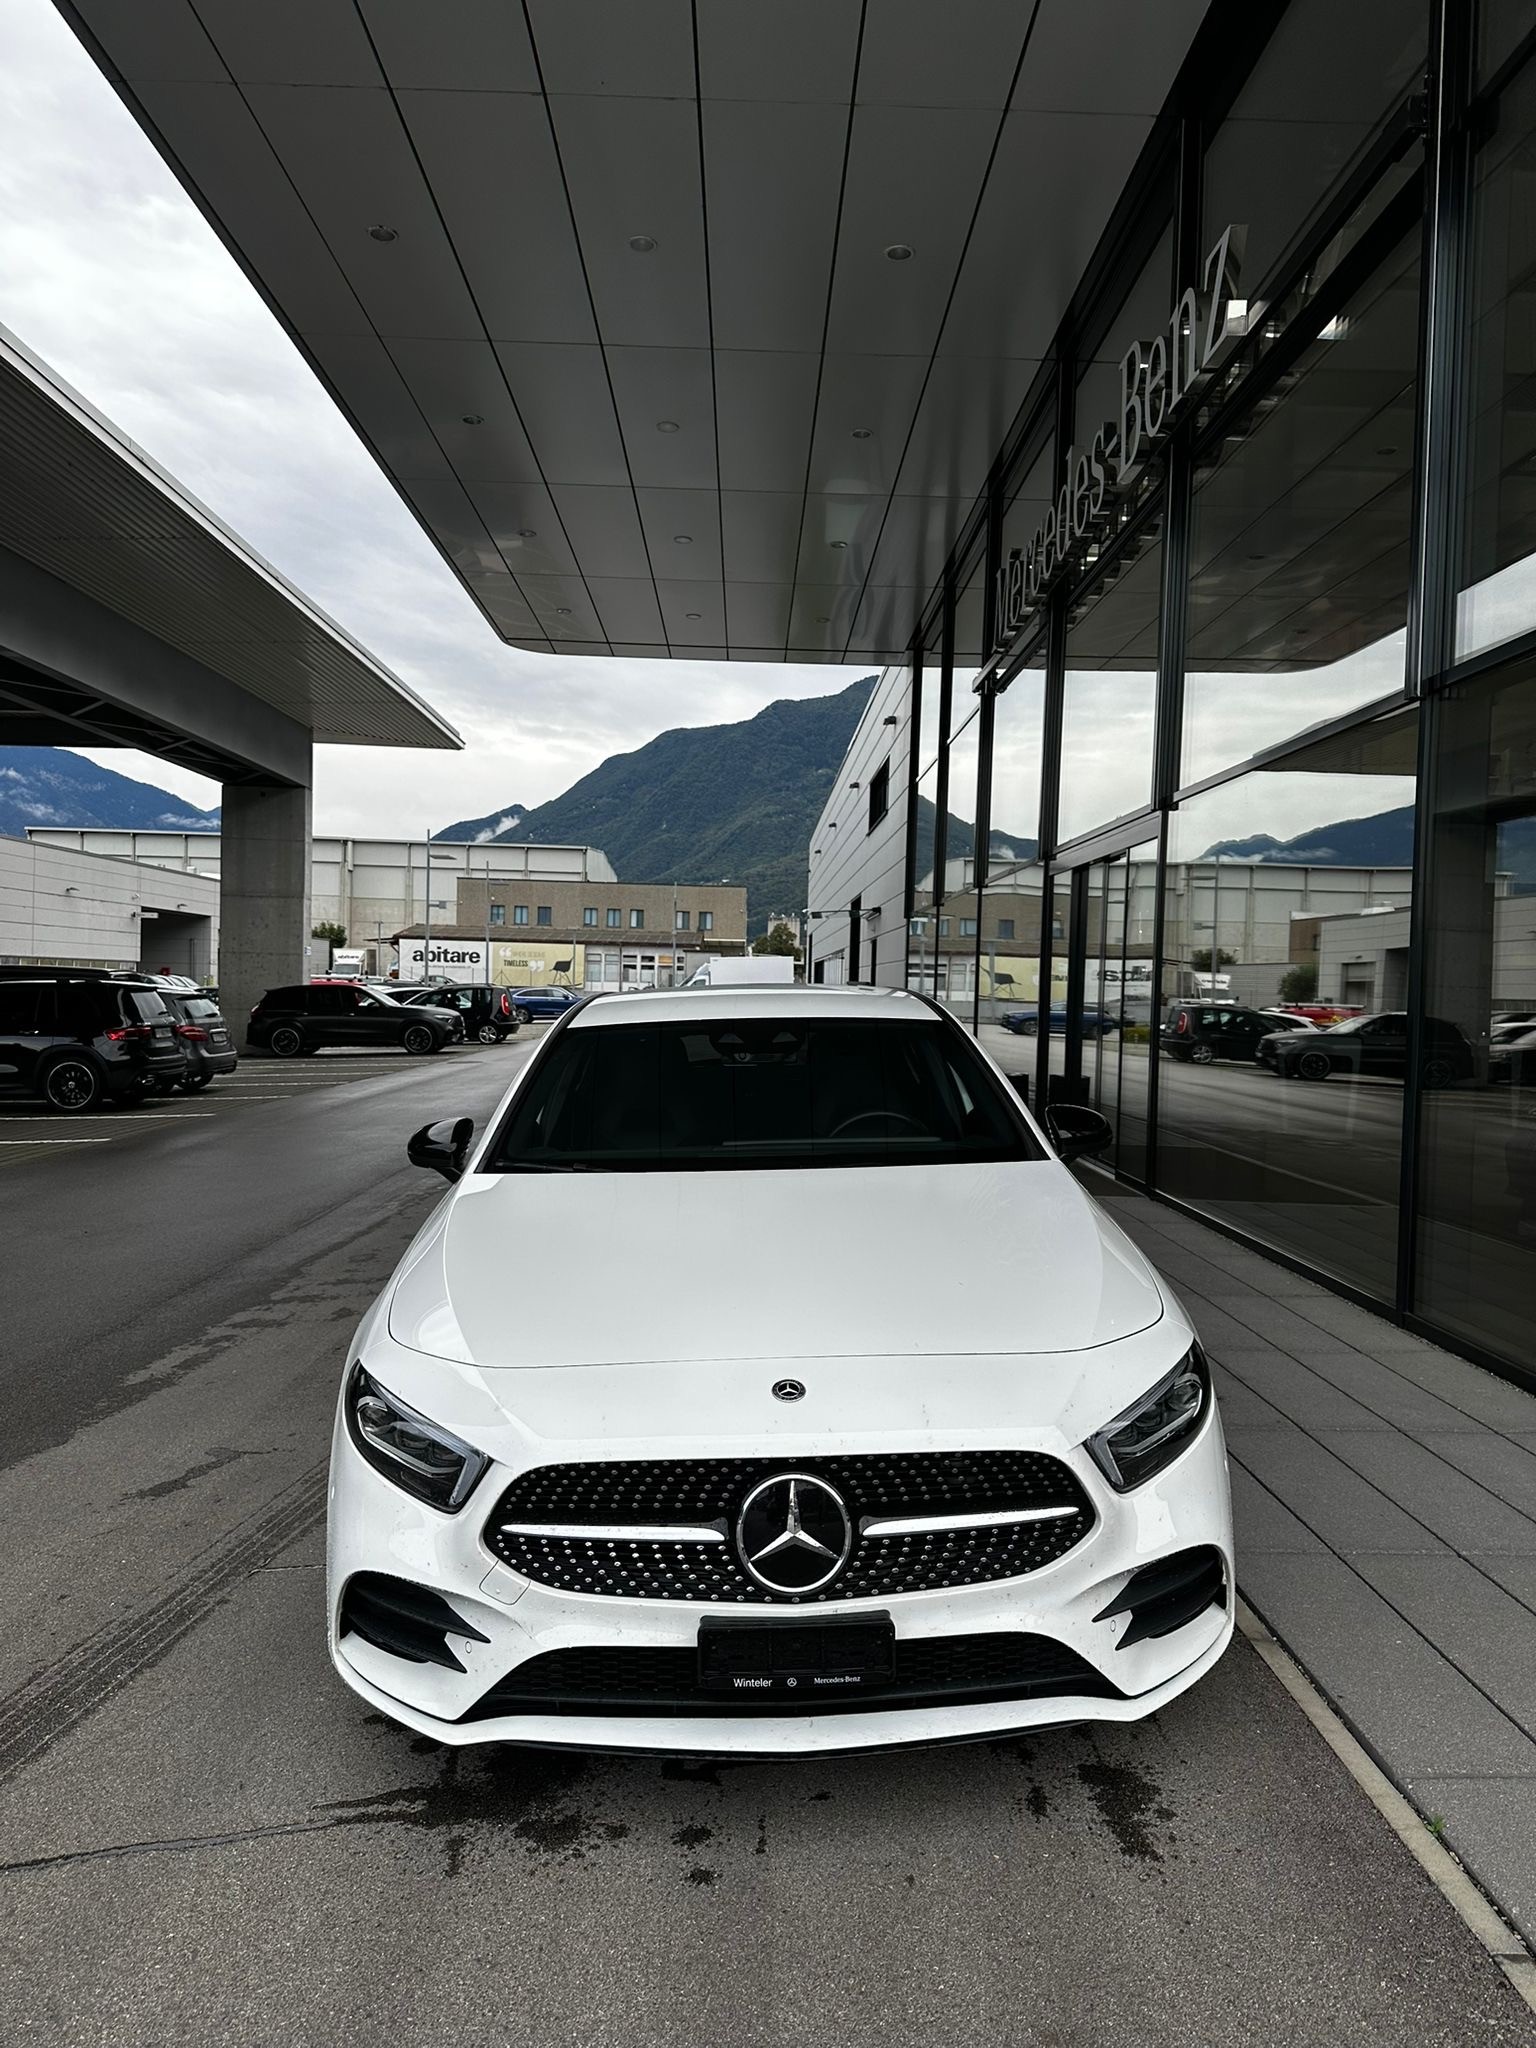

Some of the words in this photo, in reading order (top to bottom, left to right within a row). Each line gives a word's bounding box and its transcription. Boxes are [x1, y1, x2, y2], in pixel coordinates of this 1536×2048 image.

[992, 224, 1233, 653] Mercedes-Benz
[412, 946, 481, 964] abitare
[733, 1678, 773, 1688] Winteler
[814, 1675, 861, 1685] Mercedes-Benz
